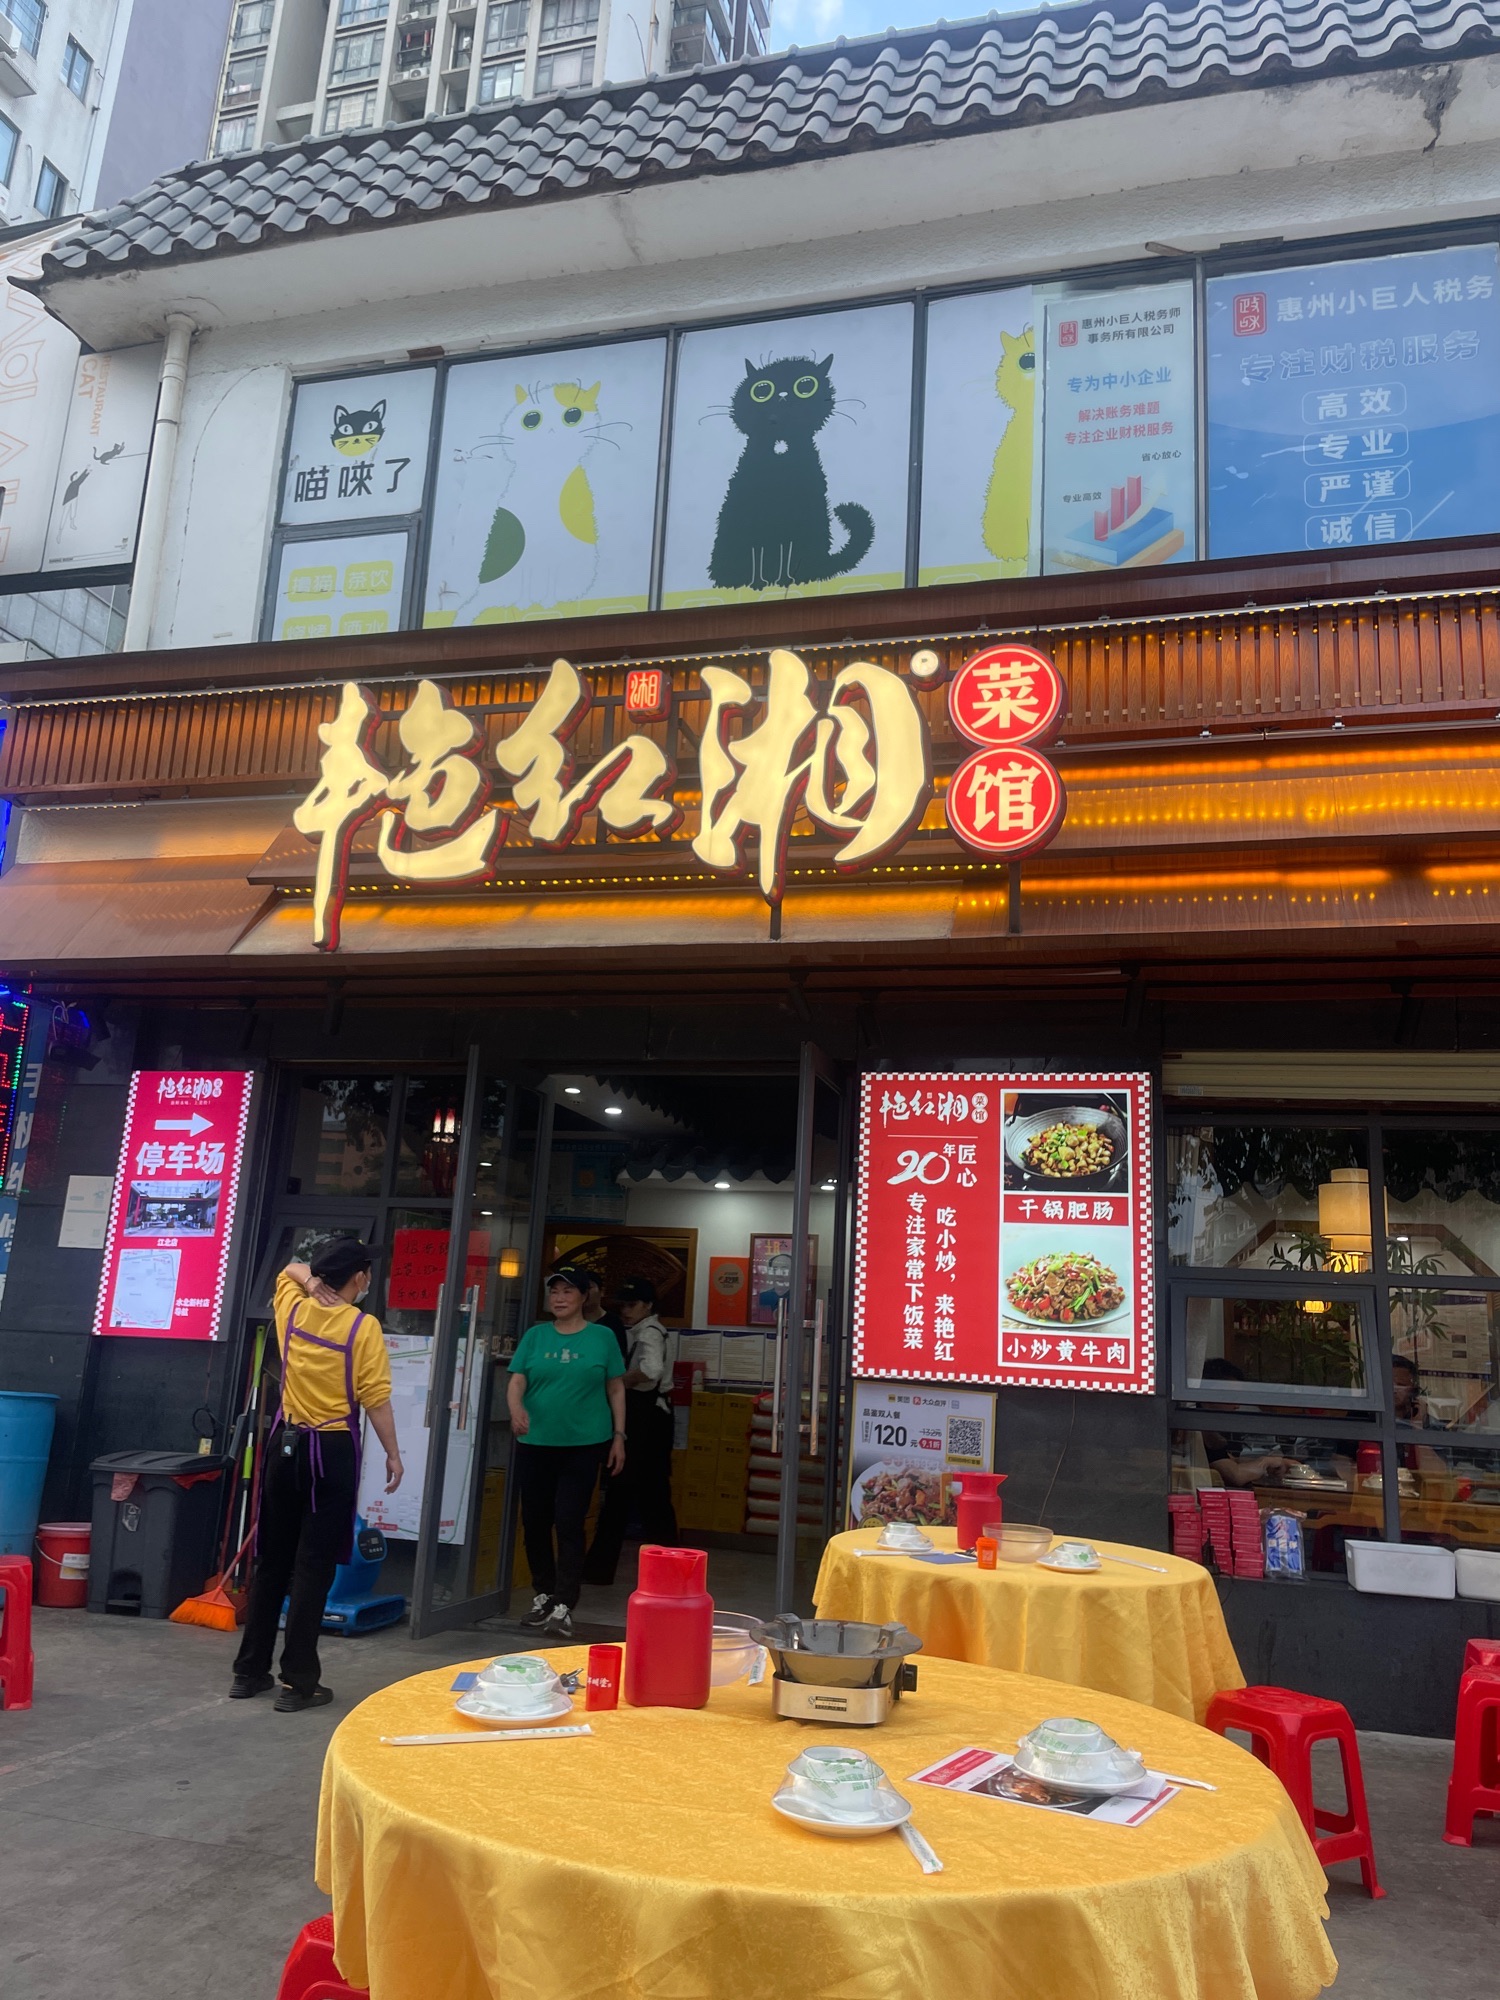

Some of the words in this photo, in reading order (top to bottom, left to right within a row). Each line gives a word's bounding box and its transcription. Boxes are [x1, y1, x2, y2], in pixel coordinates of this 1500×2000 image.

[1277, 275, 1494, 323] 惠州小巨人税务
[1082, 307, 1181, 330] 惠州小巨人税务师
[1088, 324, 1175, 344] 事务所有限公司
[1240, 330, 1480, 384] 专注财税服务
[78, 358, 98, 400] CAT
[1067, 366, 1171, 393] 专为中小企业
[89, 355, 112, 437] RESTAURANT
[1317, 387, 1392, 421] 高效
[1078, 401, 1160, 423] 解决账务难题
[1065, 421, 1174, 445] 专注企业财税服务
[1318, 429, 1394, 460] 专业
[1142, 450, 1182, 462] 省心放心
[1063, 492, 1102, 503] 专业高效
[1320, 469, 1396, 503] 严谨
[1320, 512, 1397, 544] 诚信
[966, 660, 1042, 832] 菜馆
[136, 1141, 226, 1176] 停车场
[887, 1150, 951, 1185] 20
[943, 1143, 956, 1157] 年
[957, 1144, 978, 1187] 匠心
[1018, 1198, 1115, 1221] 干锅肥肠
[903, 1192, 927, 1350] 专注家常下饭菜
[1007, 1338, 1126, 1365] 小炒黄牛肉
[922, 1398, 946, 1407] 大众点评
[874, 1424, 907, 1447] 120
[921, 1438, 941, 1450] 9.1折
